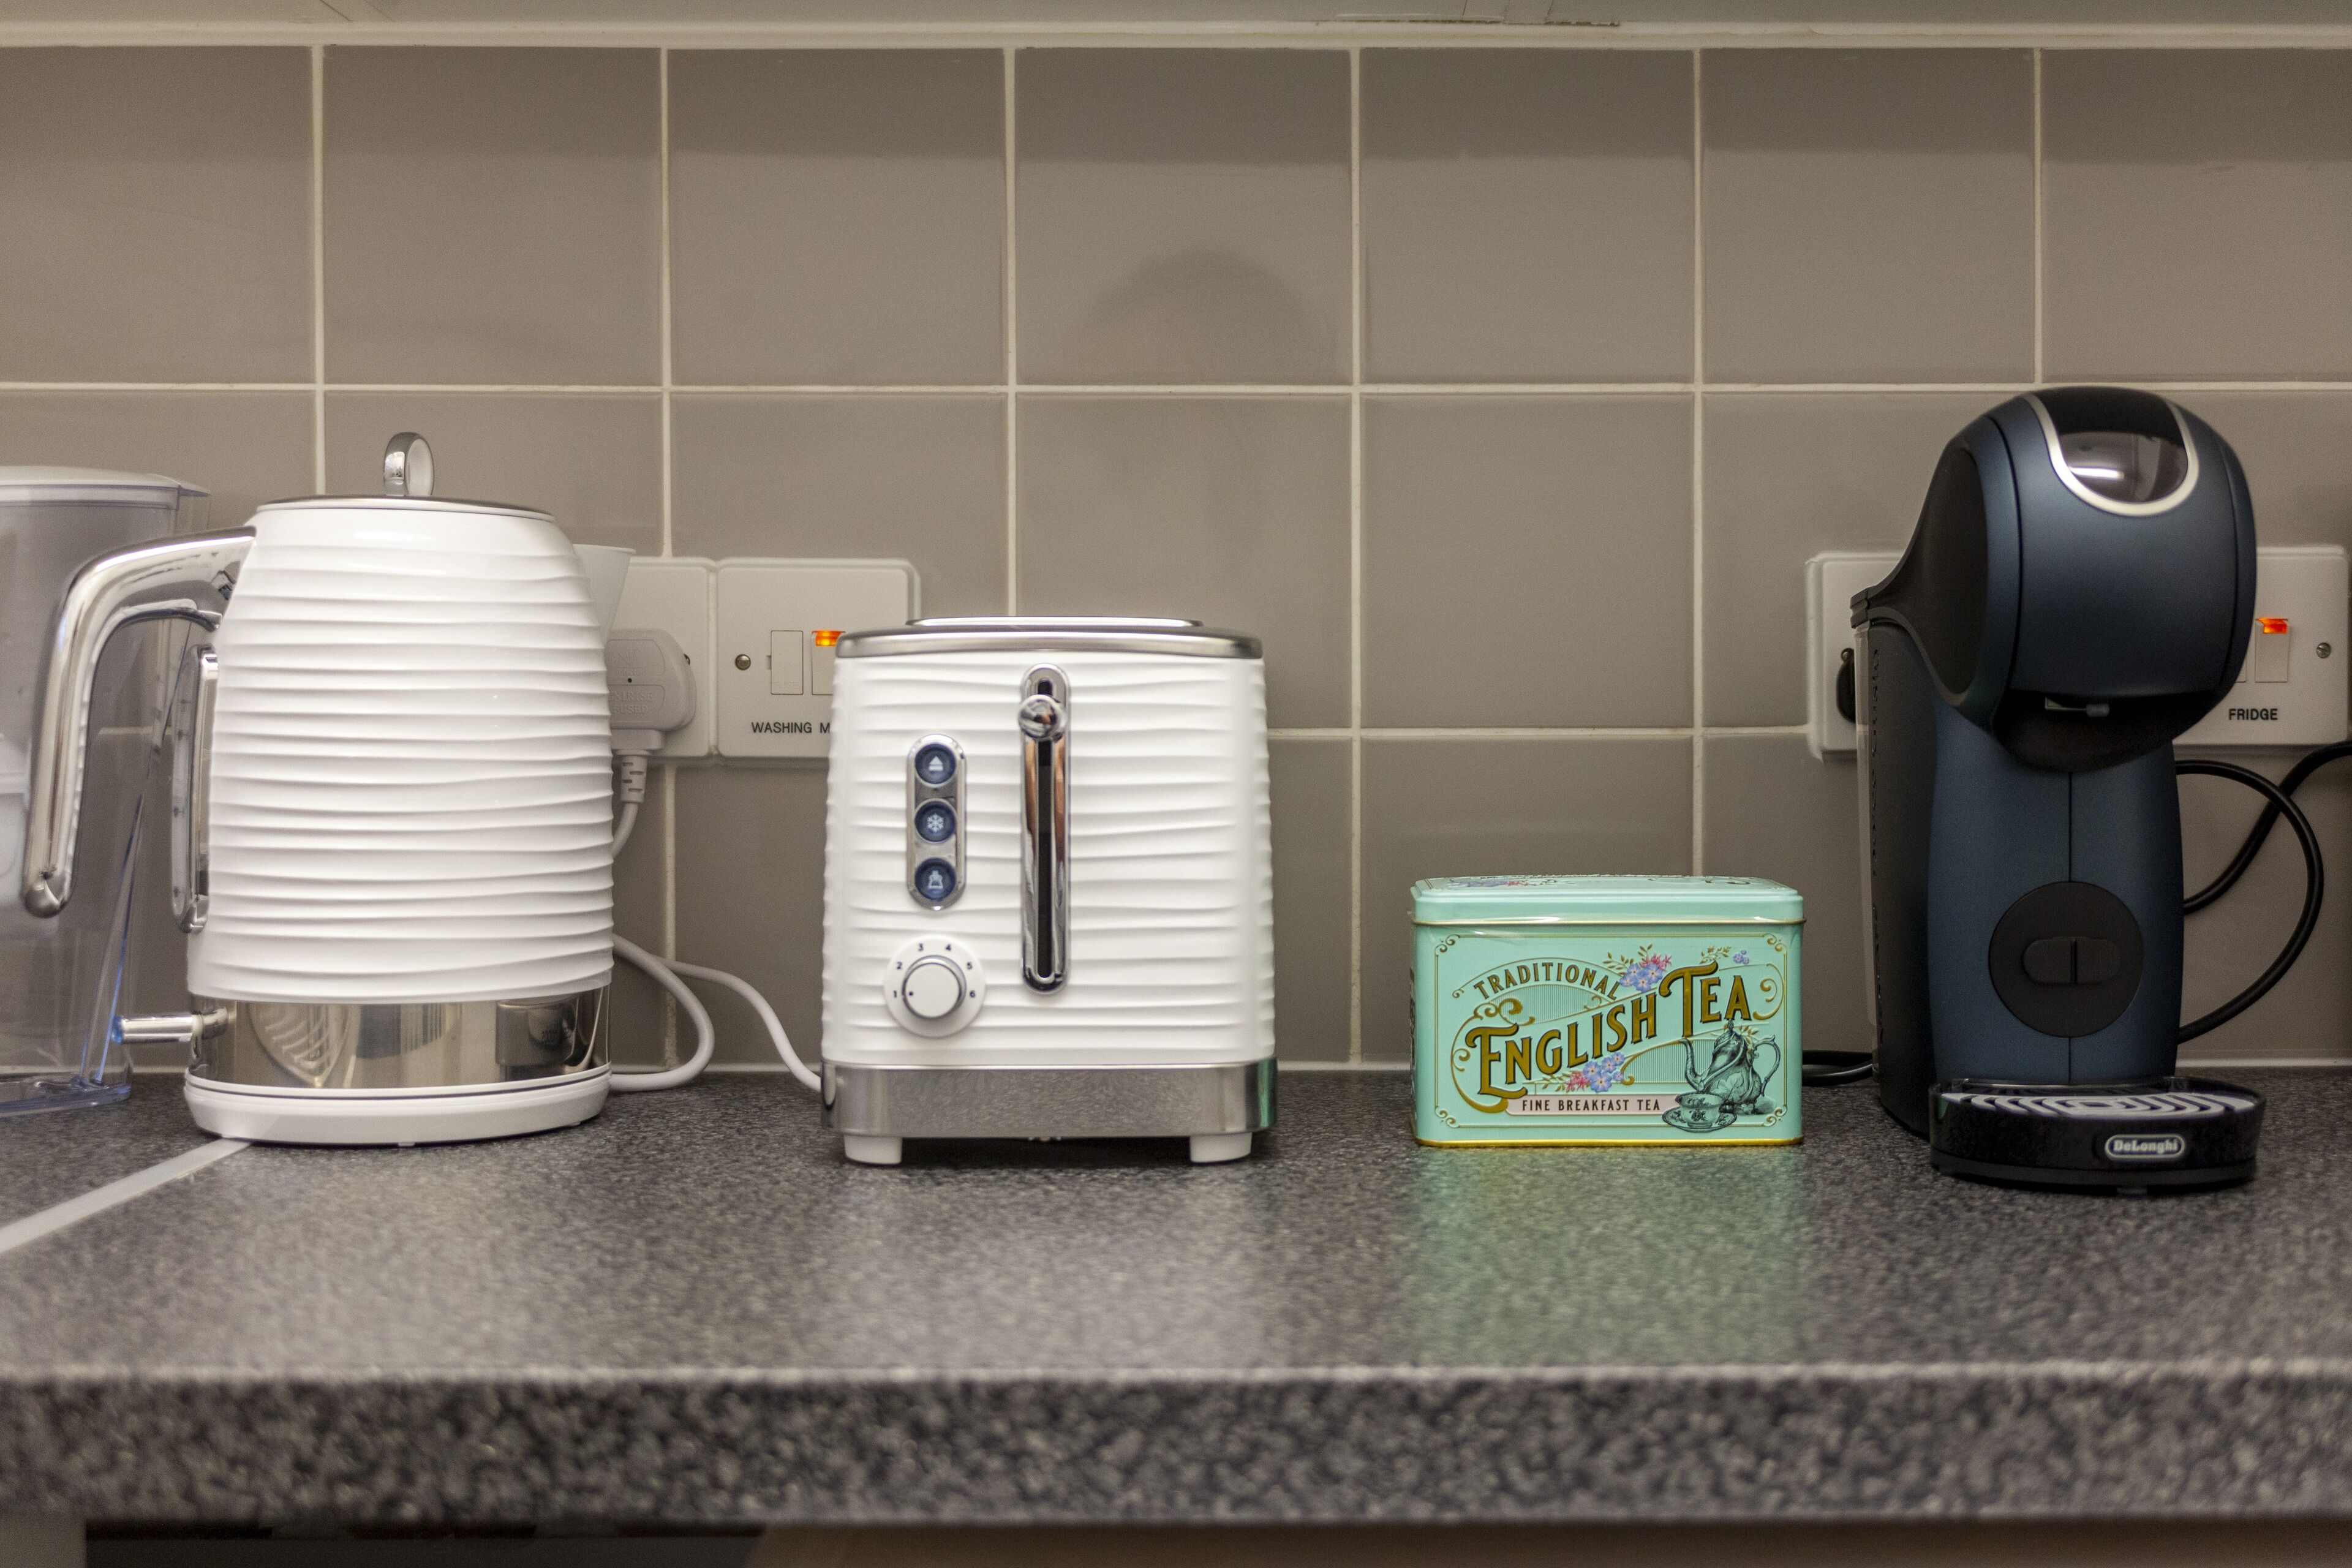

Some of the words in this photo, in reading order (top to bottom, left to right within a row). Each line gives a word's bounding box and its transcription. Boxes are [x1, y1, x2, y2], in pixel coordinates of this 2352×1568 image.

[2228, 708, 2278, 720] FRIDGE
[751, 722, 812, 734] WASHING
[820, 722, 831, 733] M
[1473, 962, 1621, 1001] TRADITIONAL
[1465, 992, 1657, 1099] ENGLISH
[1659, 960, 1752, 1037] TEA
[1522, 1099, 1551, 1111] FINE
[1558, 1099, 1630, 1111] BREAKFAST
[1637, 1099, 1660, 1111] TEA
